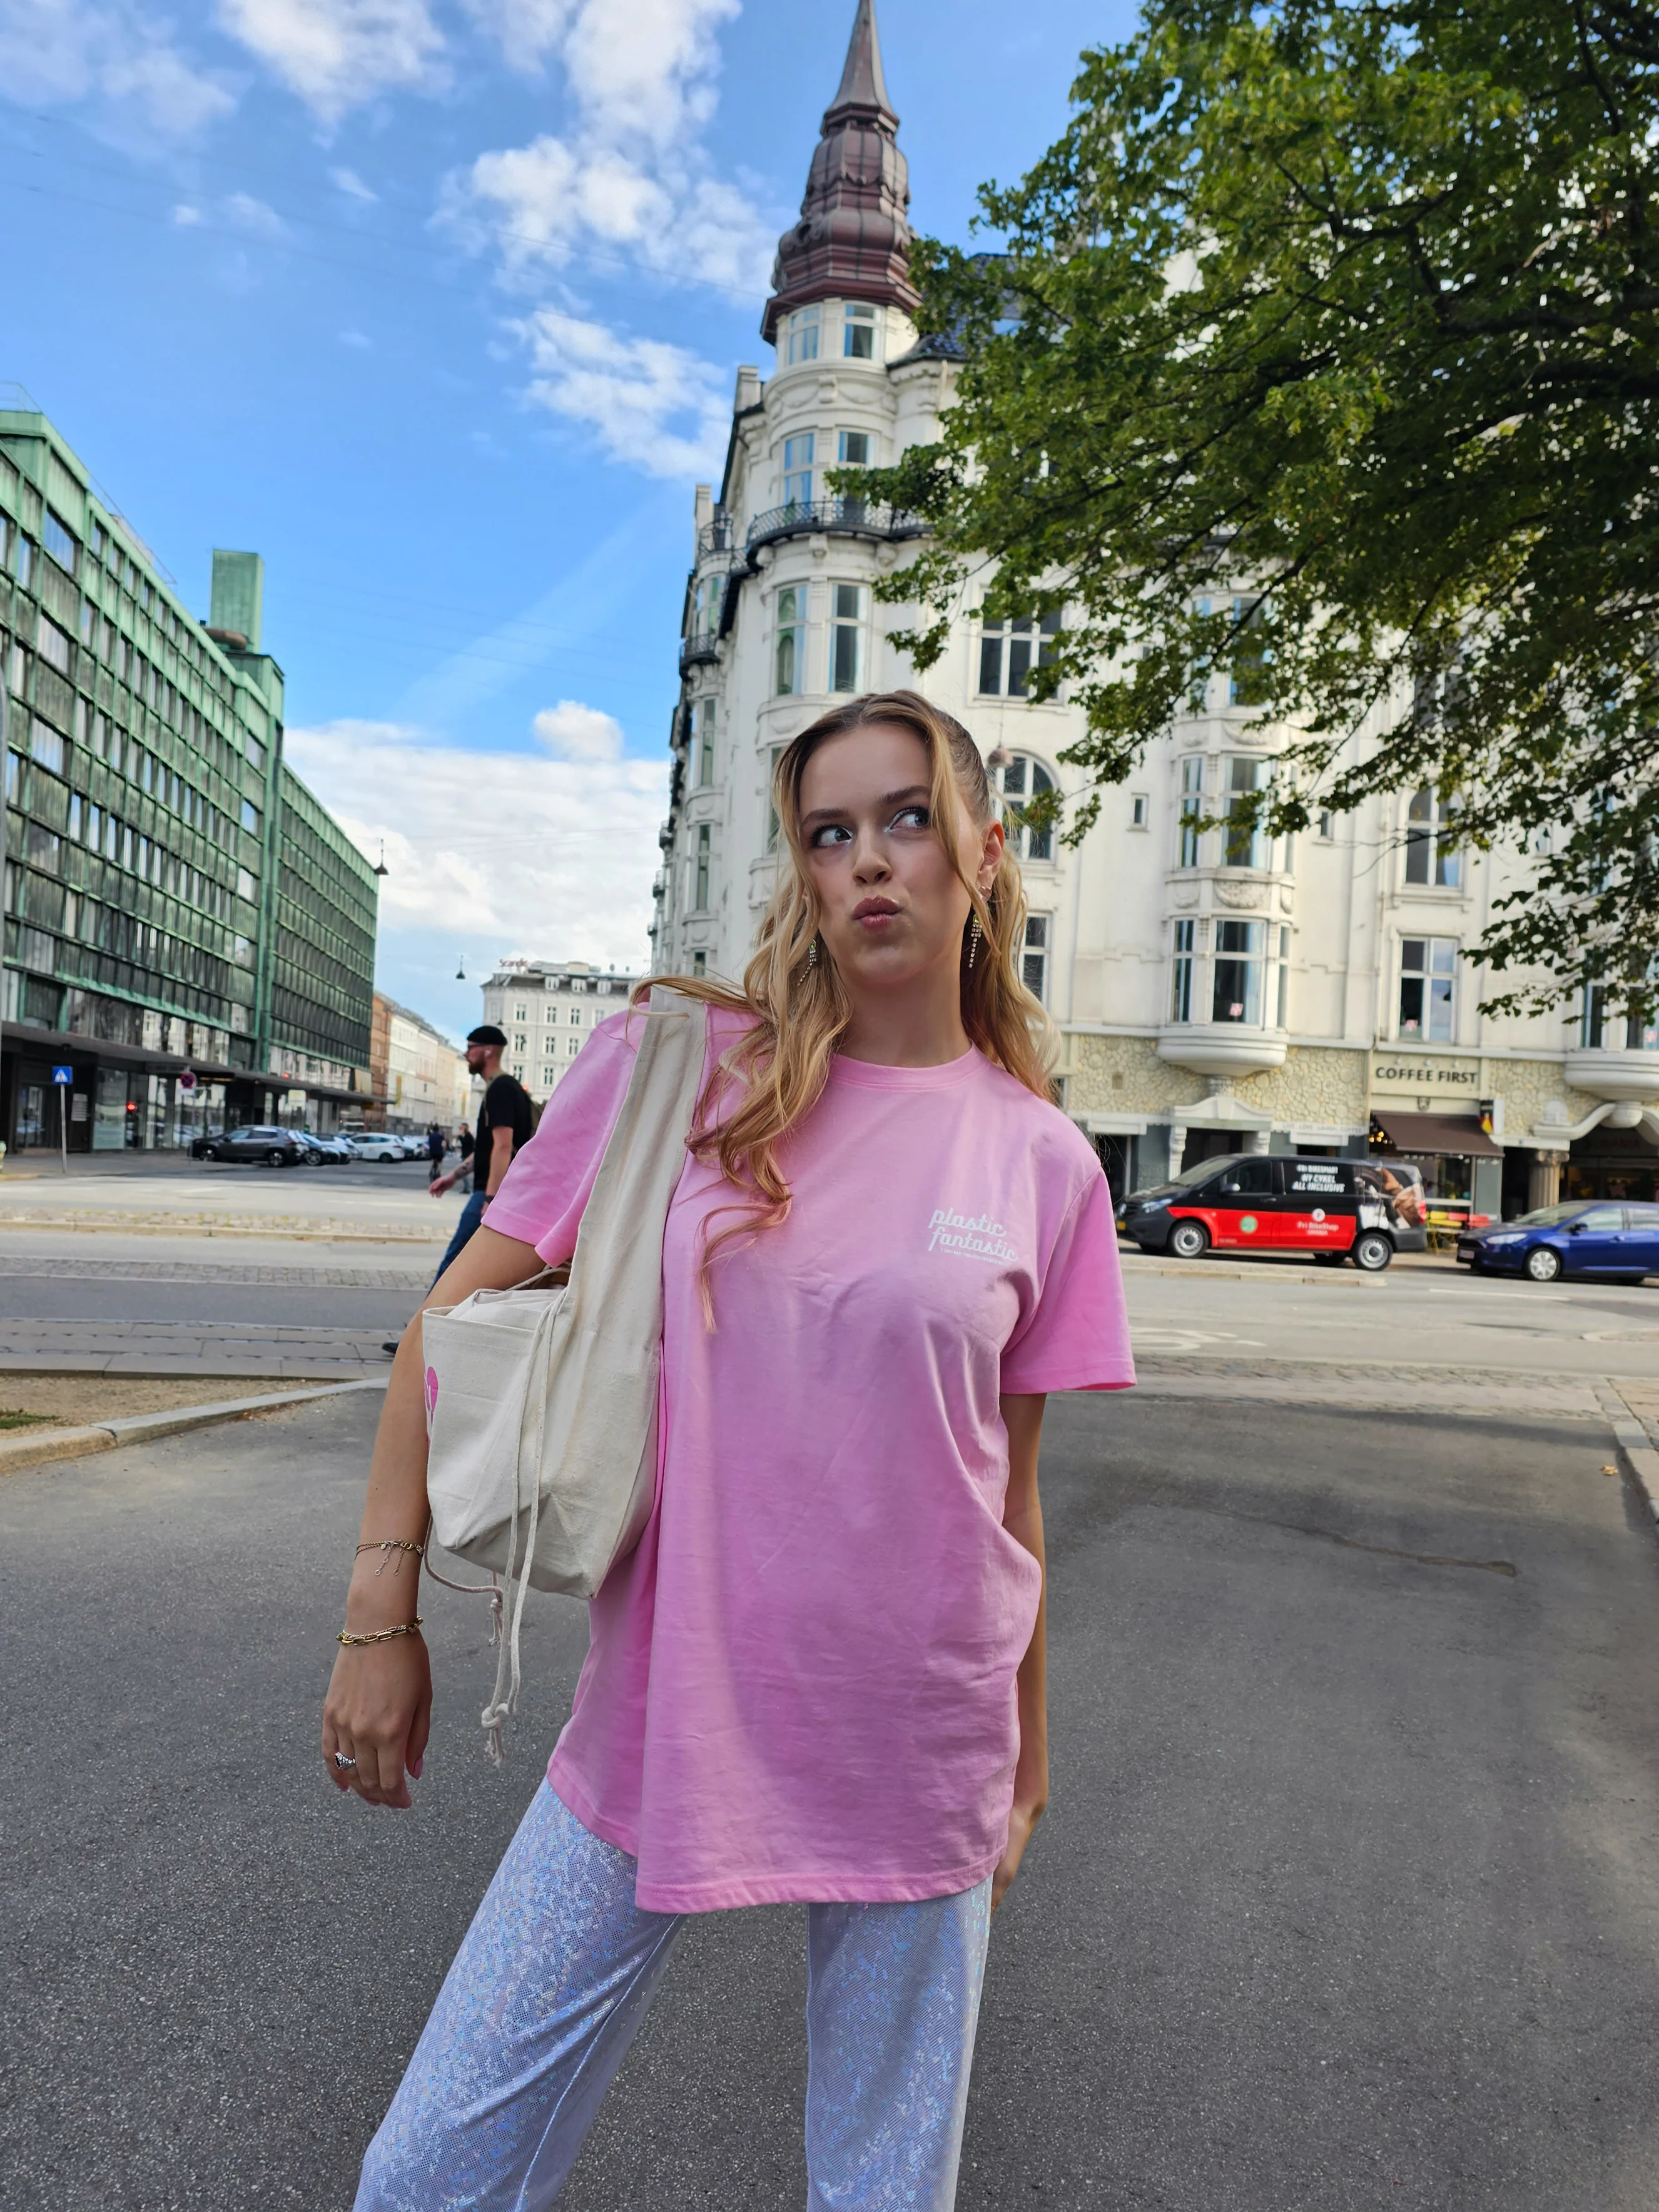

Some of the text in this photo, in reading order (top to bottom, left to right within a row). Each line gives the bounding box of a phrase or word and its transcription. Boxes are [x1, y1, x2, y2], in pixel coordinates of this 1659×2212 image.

[1376, 1067, 1479, 1083] COFFEE FIRST
[1292, 1181, 1345, 1193] ALL INCLUSIVE
[1313, 1174, 1336, 1184] CYKEL
[928, 1207, 1007, 1237] plastic
[928, 1226, 1018, 1262] fantastic
